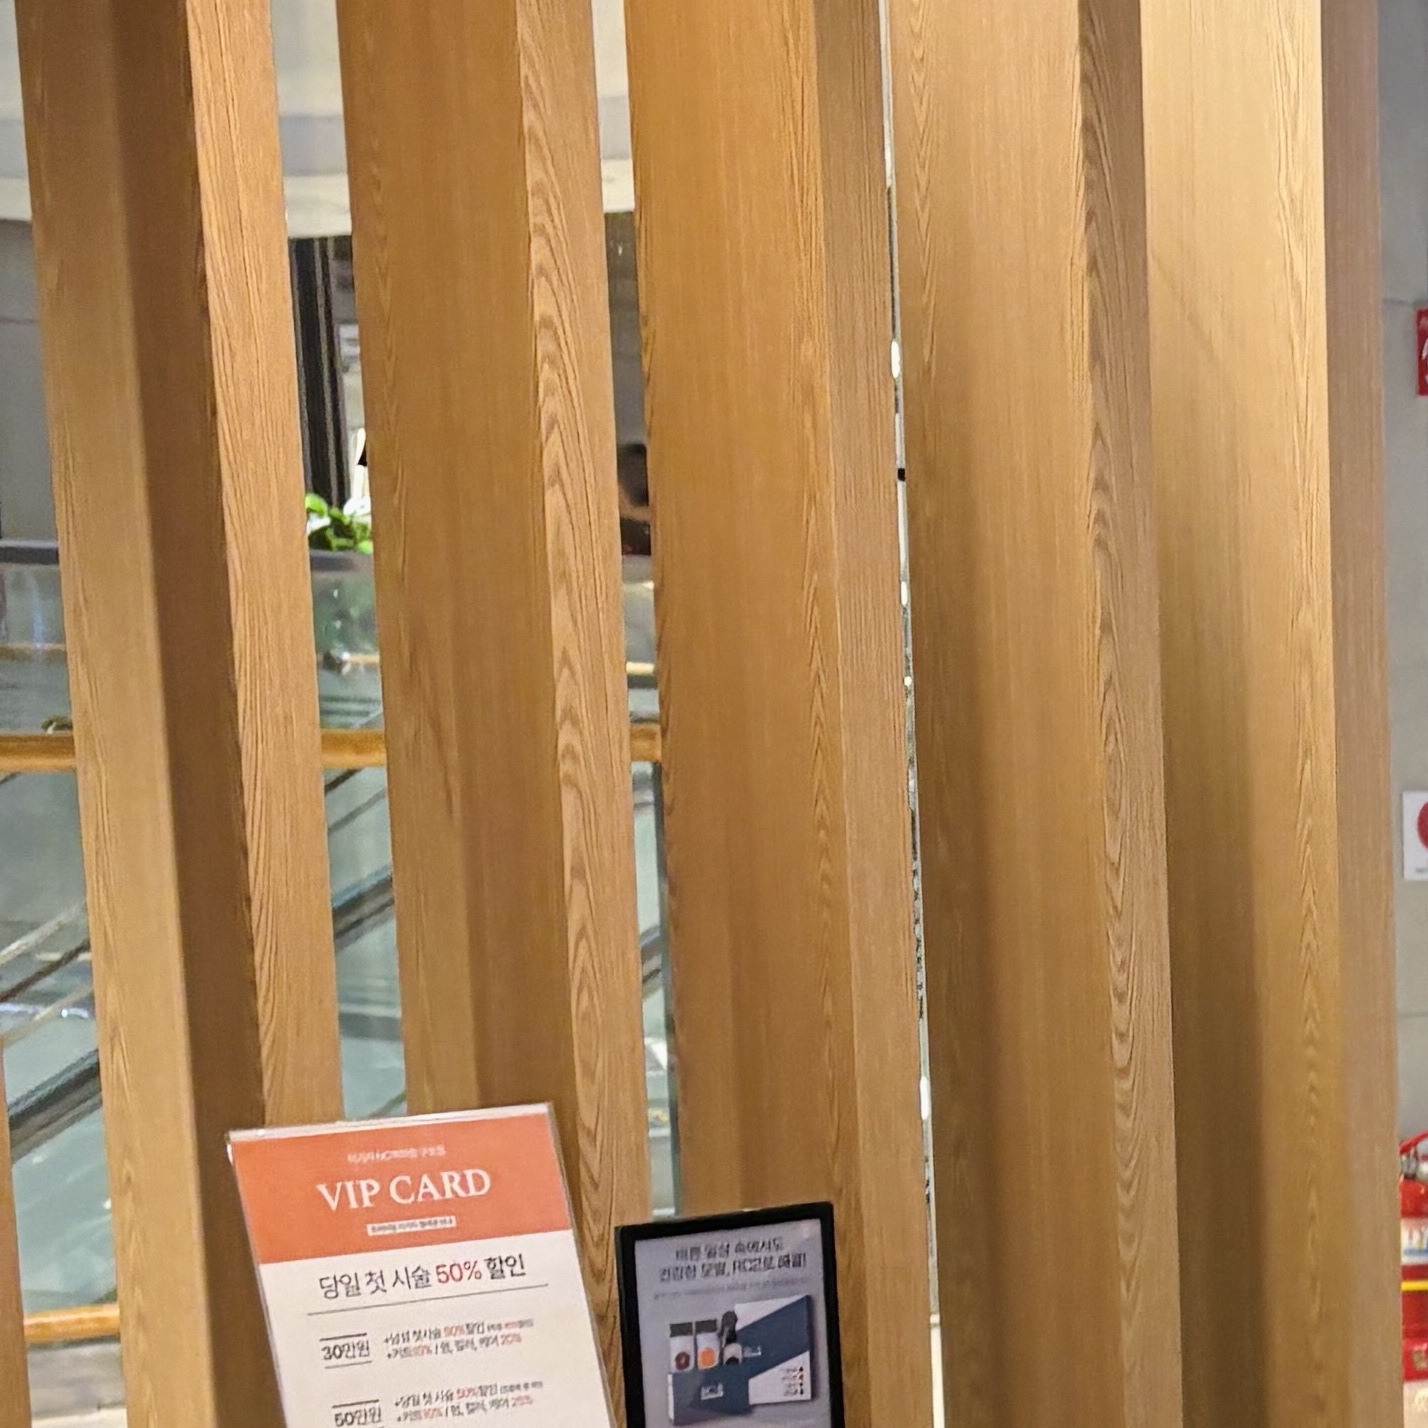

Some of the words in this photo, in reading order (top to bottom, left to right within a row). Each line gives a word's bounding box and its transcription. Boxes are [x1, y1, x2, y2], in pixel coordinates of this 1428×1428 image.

[316, 1178, 381, 1212] VIP
[389, 1168, 492, 1205] CARD
[319, 1272, 361, 1300] 당일
[364, 1270, 388, 1295] 첫
[392, 1264, 432, 1291] 시술
[436, 1260, 482, 1285] 50%
[483, 1253, 526, 1280] 할인
[321, 1340, 370, 1361] 30만원
